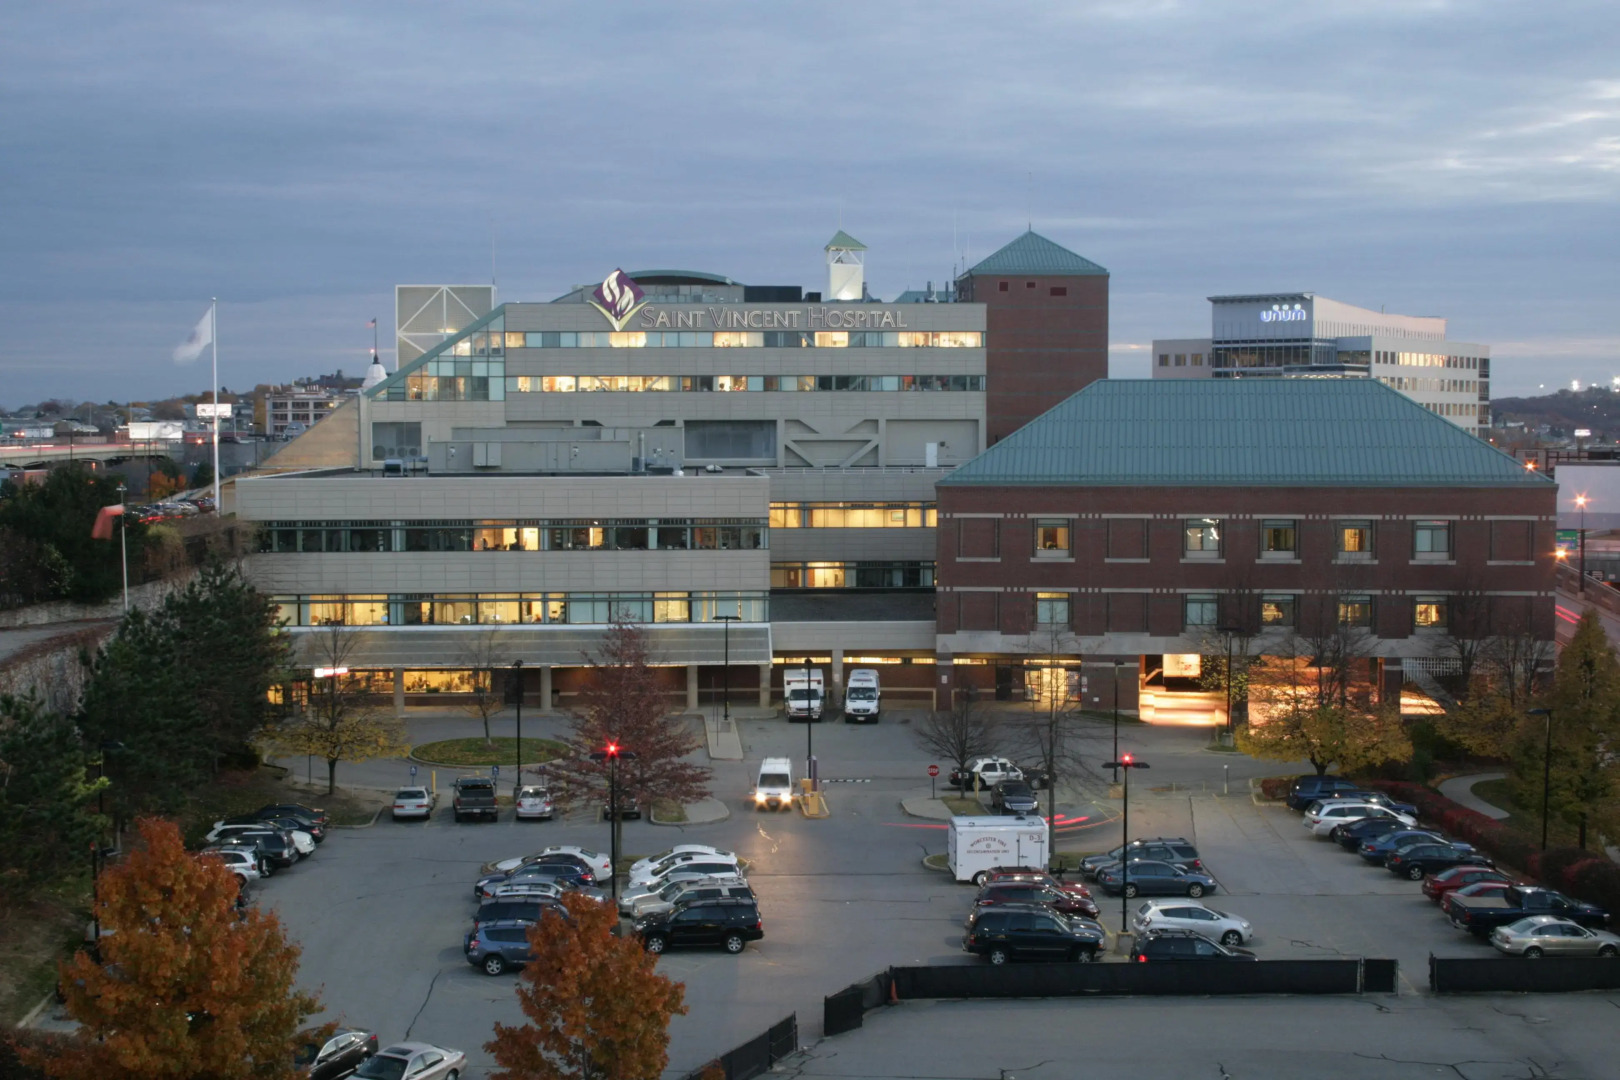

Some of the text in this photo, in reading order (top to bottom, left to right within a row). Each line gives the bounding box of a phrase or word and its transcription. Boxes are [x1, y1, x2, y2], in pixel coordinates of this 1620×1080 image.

[640, 306, 908, 329] SAINT VINCENT HOSPITAL
[1260, 304, 1306, 322] unum
